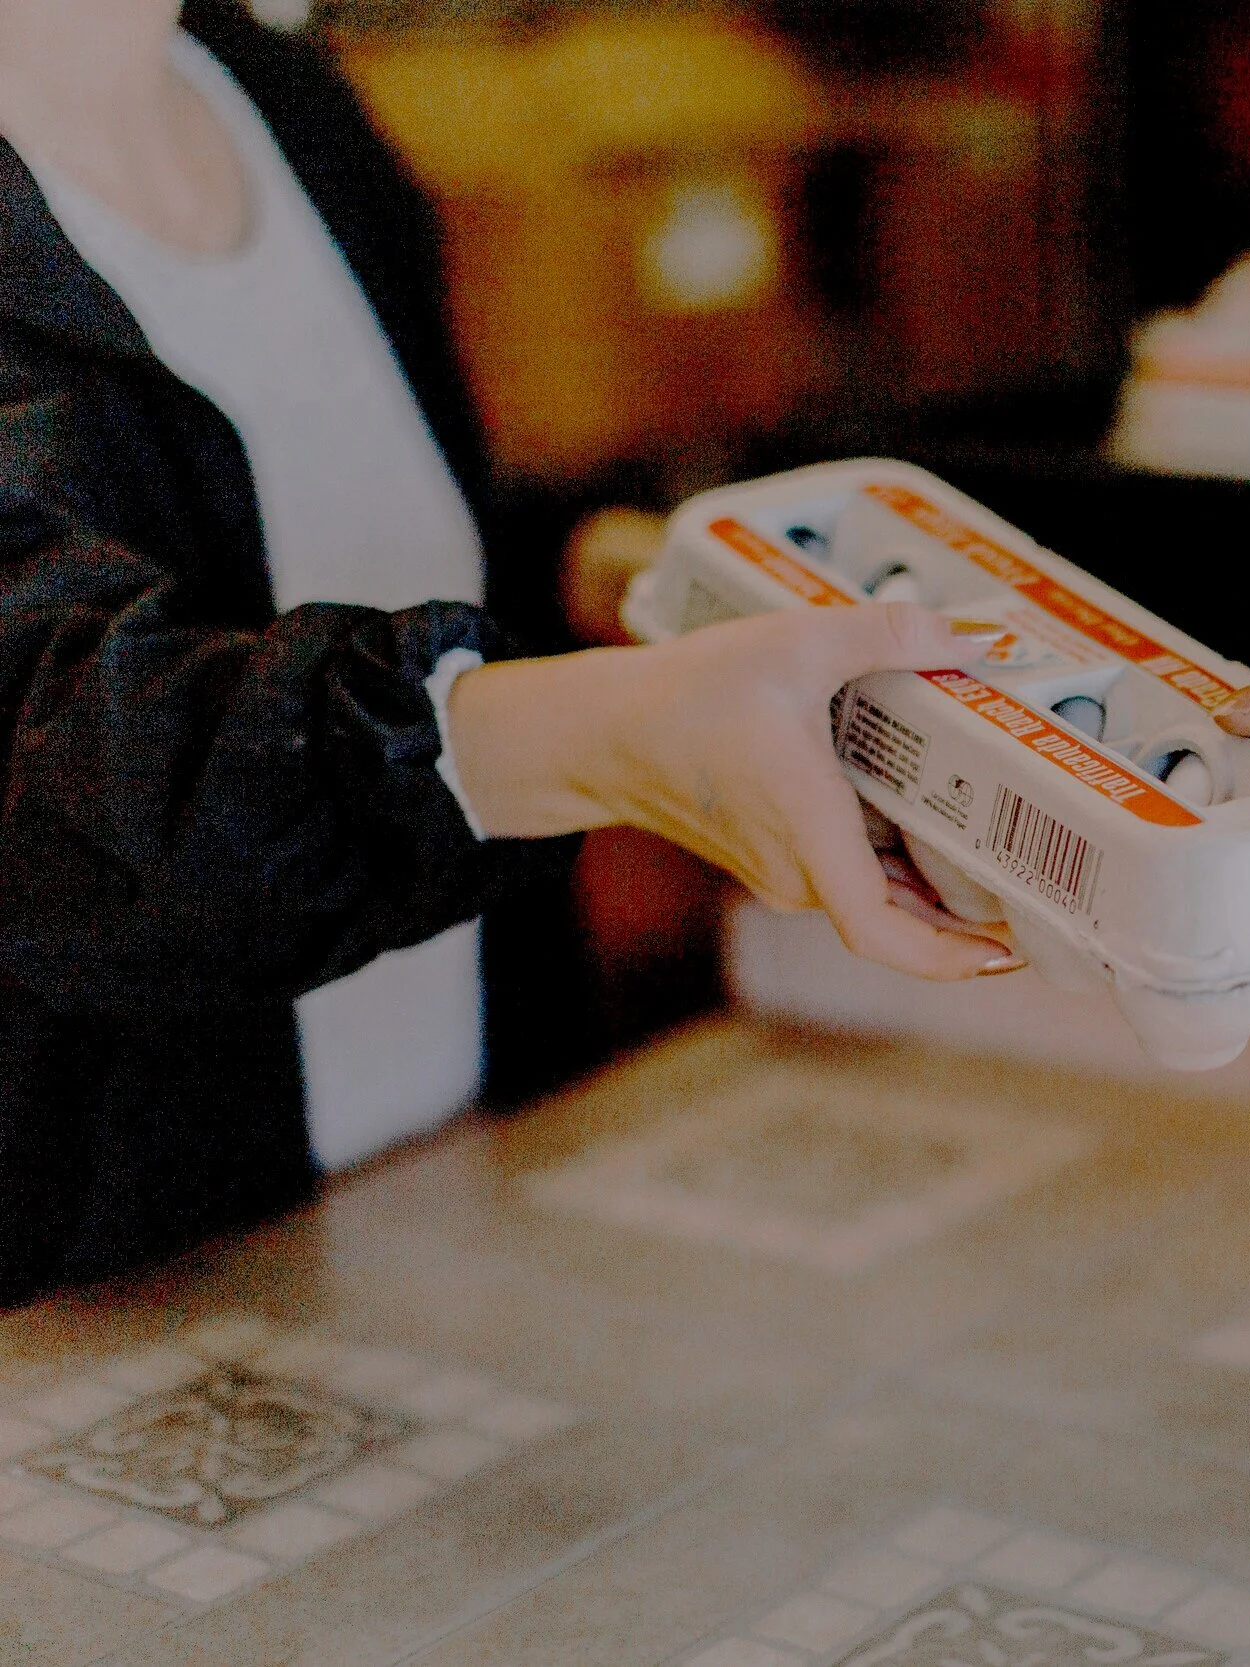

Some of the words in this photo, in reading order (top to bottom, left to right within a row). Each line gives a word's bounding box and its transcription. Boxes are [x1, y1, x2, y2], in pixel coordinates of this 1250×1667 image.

[931, 674, 992, 702] Eggs
[976, 697, 1046, 738] Ranch
[1033, 734, 1146, 802] Trafficanda
[975, 838, 981, 849] 0
[997, 851, 1034, 885] 43922
[1039, 878, 1076, 914] 00040
